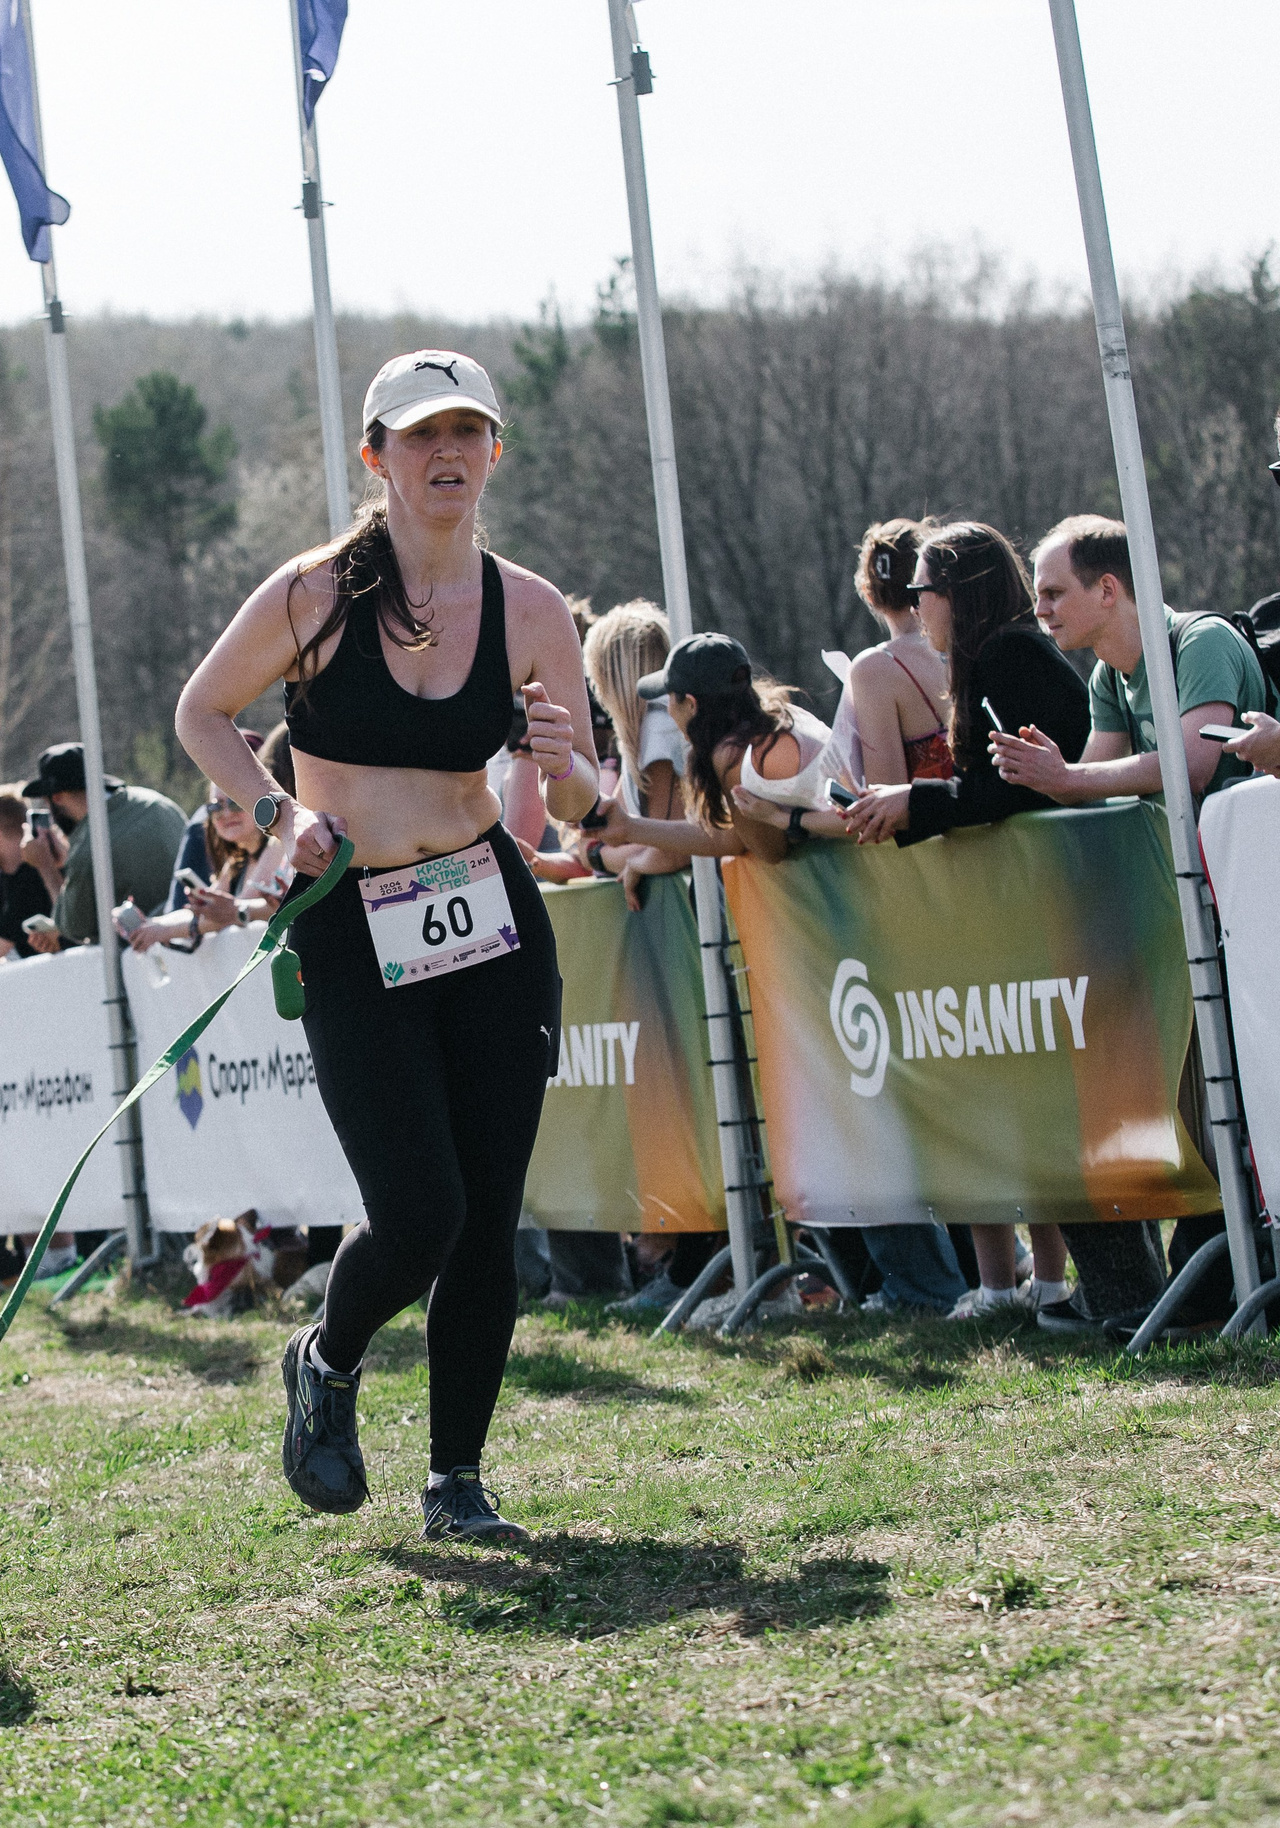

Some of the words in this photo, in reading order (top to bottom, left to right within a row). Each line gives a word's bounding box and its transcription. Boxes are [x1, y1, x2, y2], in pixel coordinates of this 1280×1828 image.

[415, 856, 457, 877] КРОСС
[418, 860, 469, 886] БЫСТРЫЙ
[470, 860, 477, 869] 2
[379, 880, 401, 891] 19.04
[381, 885, 403, 896] 2025
[422, 896, 474, 946] 60
[894, 975, 1089, 1060] INSANITY
[547, 1021, 640, 1088] ANITY
